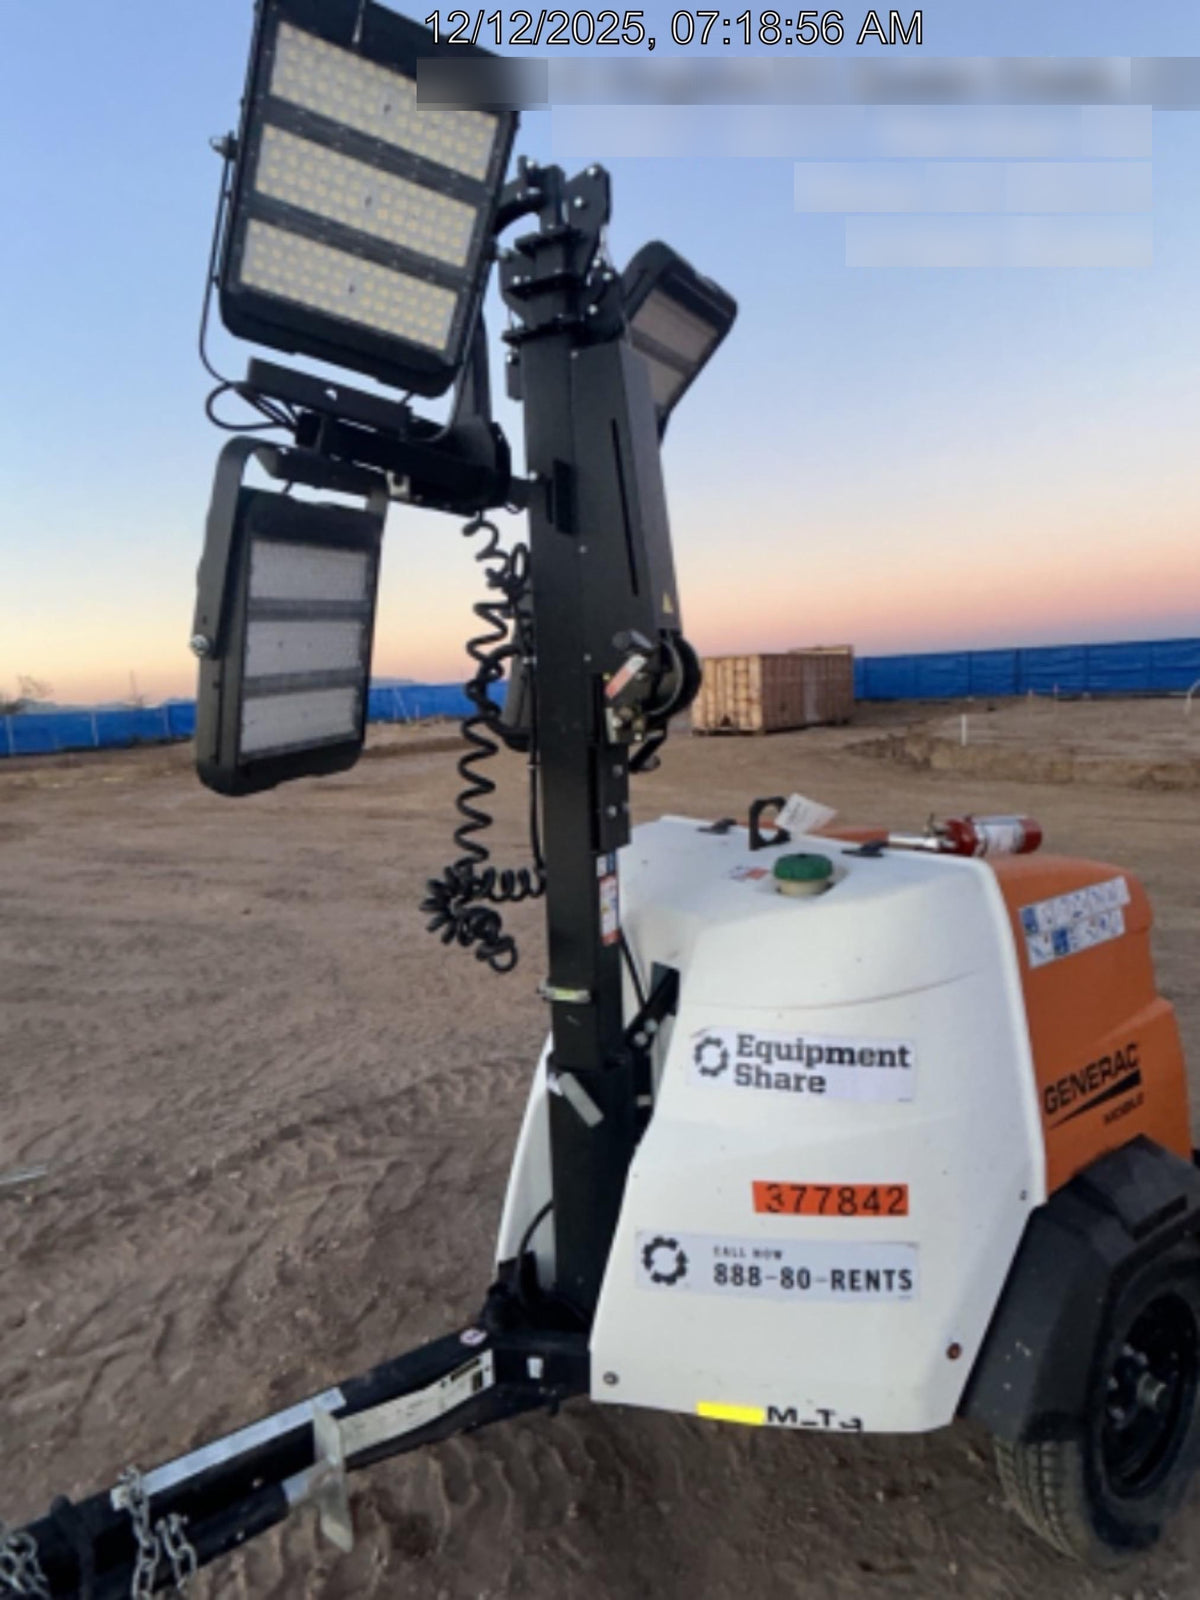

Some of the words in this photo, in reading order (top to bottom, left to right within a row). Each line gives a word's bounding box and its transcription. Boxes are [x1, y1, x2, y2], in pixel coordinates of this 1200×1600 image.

[736, 1033, 911, 1069] Equipment
[735, 1063, 827, 1094] Share
[1044, 1042, 1138, 1114] GENERAC
[766, 1183, 906, 1216] 377842
[714, 1262, 913, 1292] 888-80-RENTS
